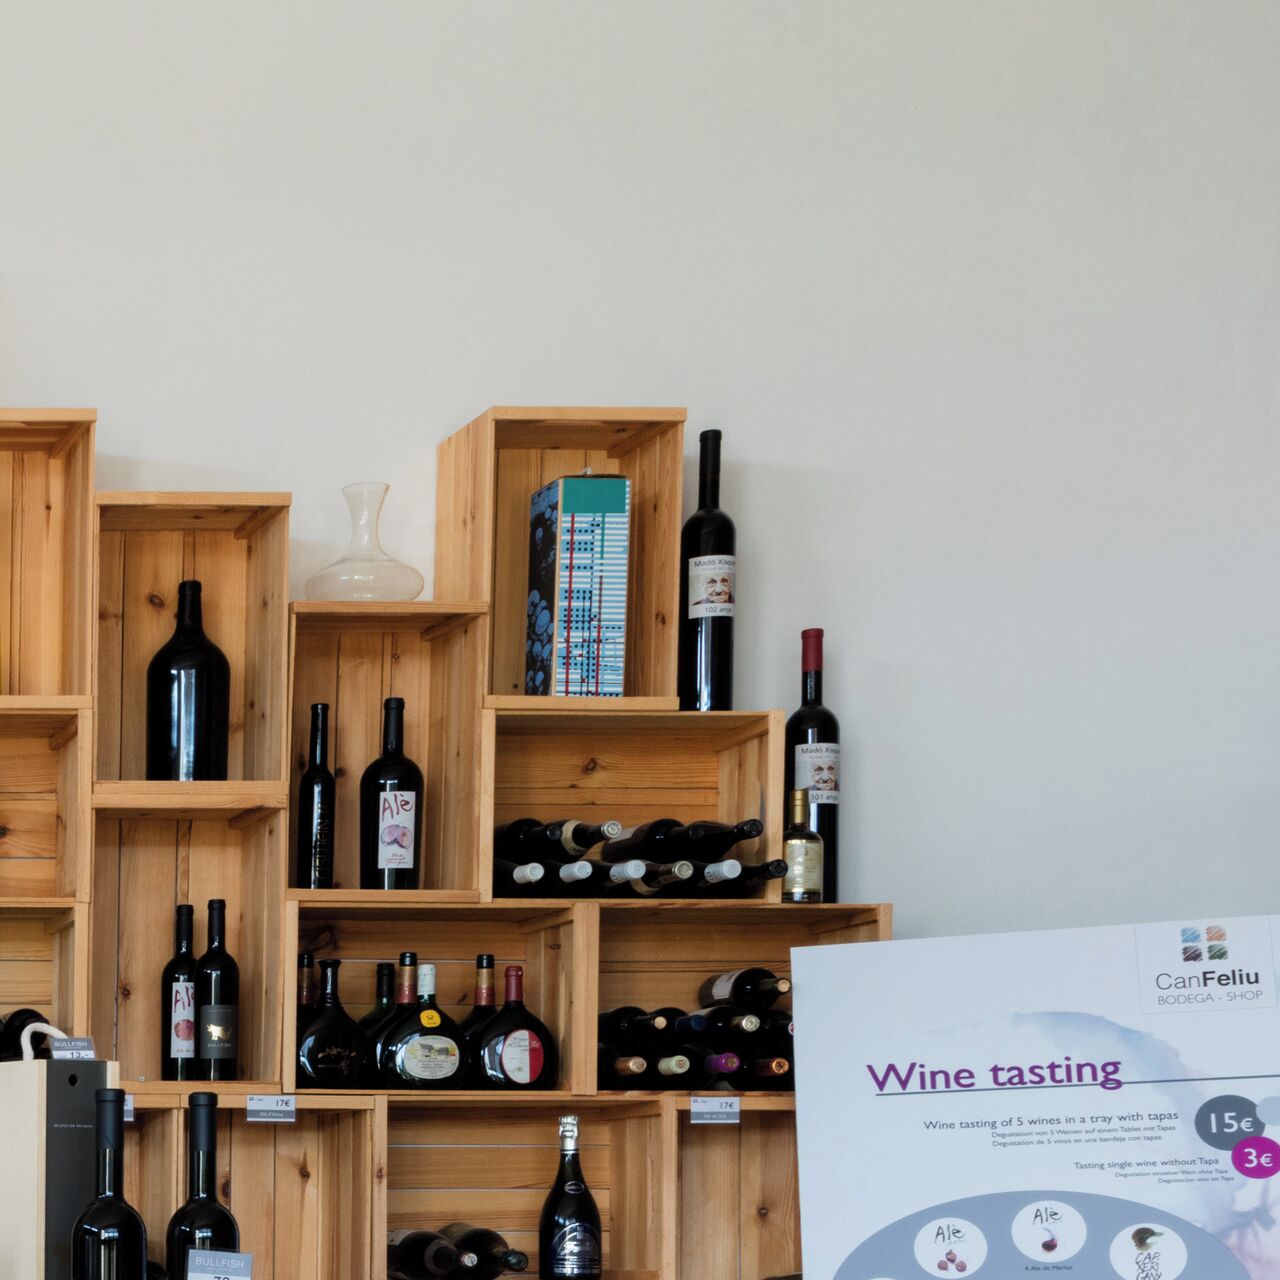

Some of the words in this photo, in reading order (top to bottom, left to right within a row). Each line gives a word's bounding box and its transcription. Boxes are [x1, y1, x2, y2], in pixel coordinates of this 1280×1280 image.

[1158, 993, 1215, 1005] BODEGA
[1227, 990, 1263, 1002] SHOP
[866, 1062, 976, 1093] Wine
[989, 1056, 1123, 1091] tasting
[275, 1099, 290, 1108] 17€
[720, 1102, 735, 1110] 17€
[924, 1120, 956, 1130] Wine
[959, 1118, 998, 1131] tasting
[1001, 1117, 1014, 1127] of
[1017, 1117, 1024, 1127] 5
[1028, 1116, 1061, 1127] wines
[1065, 1115, 1076, 1125] in
[1090, 1115, 1113, 1126] tray
[1117, 1112, 1144, 1122] with
[1147, 1112, 1179, 1123] tapas
[1073, 1161, 1106, 1171] Tasting
[1108, 1159, 1133, 1170] single
[1135, 1158, 1158, 1167] wine
[1160, 1157, 1197, 1167] without
[1198, 1156, 1220, 1168] Tapa
[1244, 1148, 1273, 1168] 3€
[195, 1256, 244, 1269] BULLFISH
